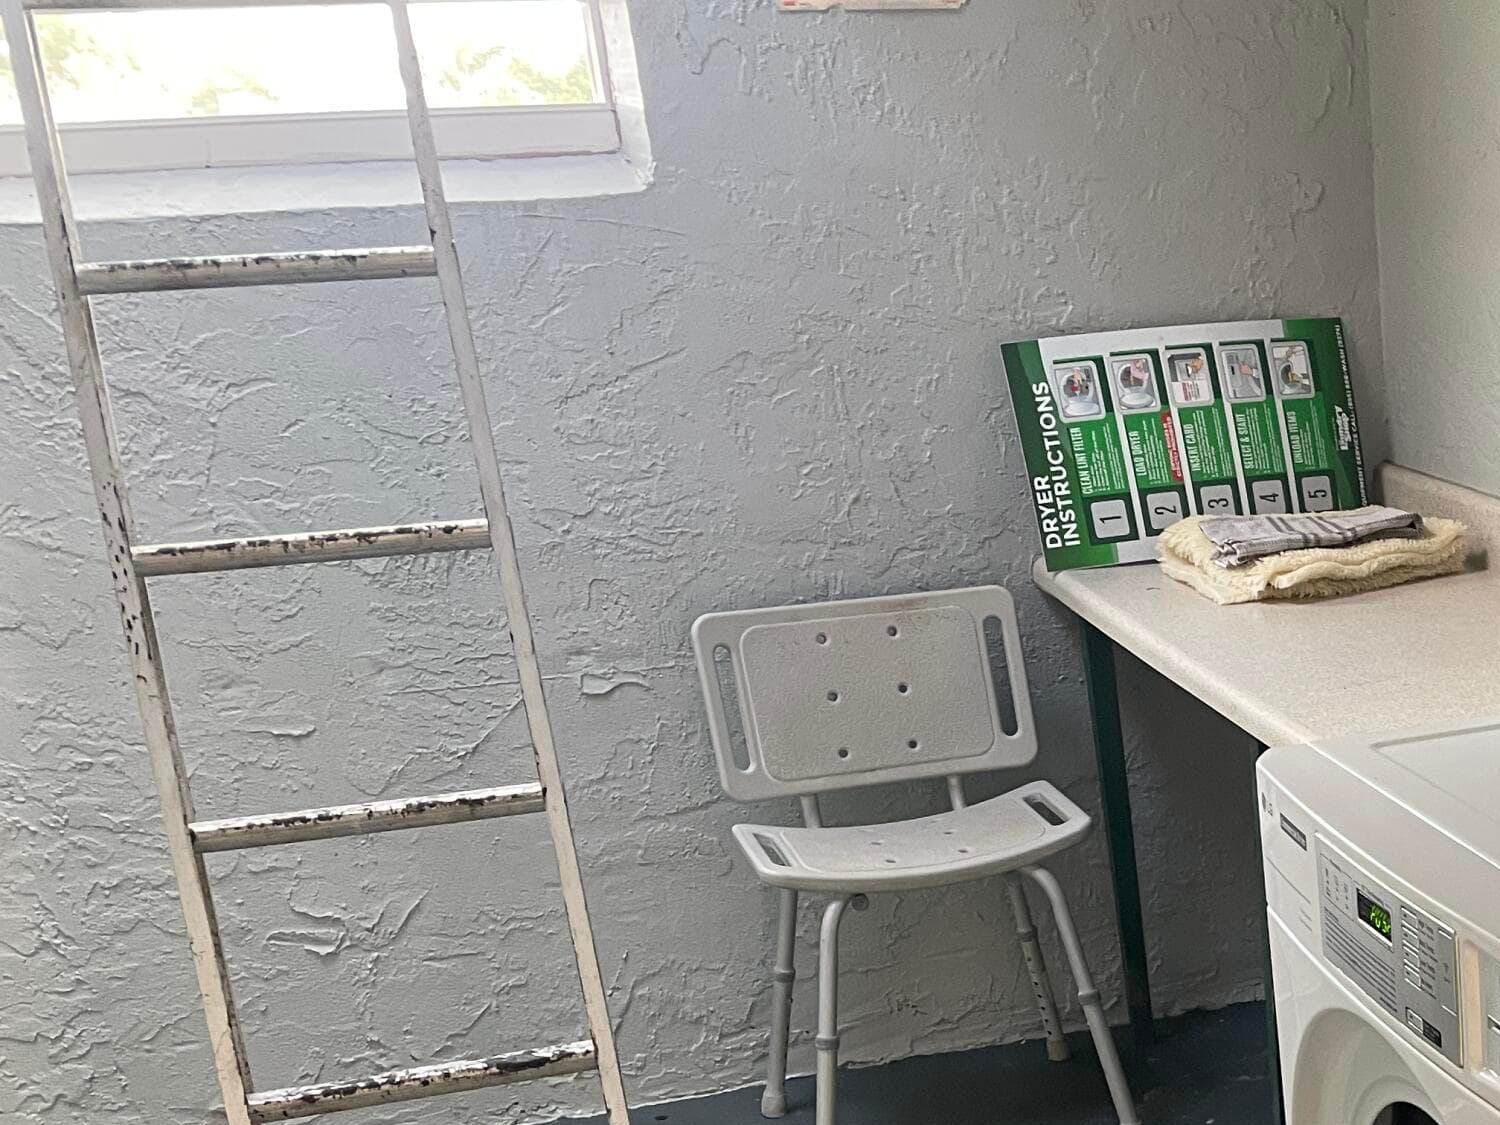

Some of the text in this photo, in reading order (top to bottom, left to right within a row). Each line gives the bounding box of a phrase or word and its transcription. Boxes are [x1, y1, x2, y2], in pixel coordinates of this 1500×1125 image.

[1235, 413, 1248, 435] START
[1183, 423, 1201, 471] INSERT CARD
[1286, 411, 1303, 463] UNLOAD ITEMS
[1032, 382, 1080, 546] INSTRUCTIONS
[1070, 427, 1093, 494] CLEAN LINT FILTER
[1128, 431, 1147, 476] LOAD DRYER
[1241, 444, 1254, 469] SELECT
[1208, 498, 1228, 508] 3
[1259, 493, 1279, 502] 4
[1308, 489, 1327, 498] 5
[1034, 476, 1062, 548] DRYER
[1100, 516, 1121, 524] 1
[1155, 506, 1176, 515] 2
